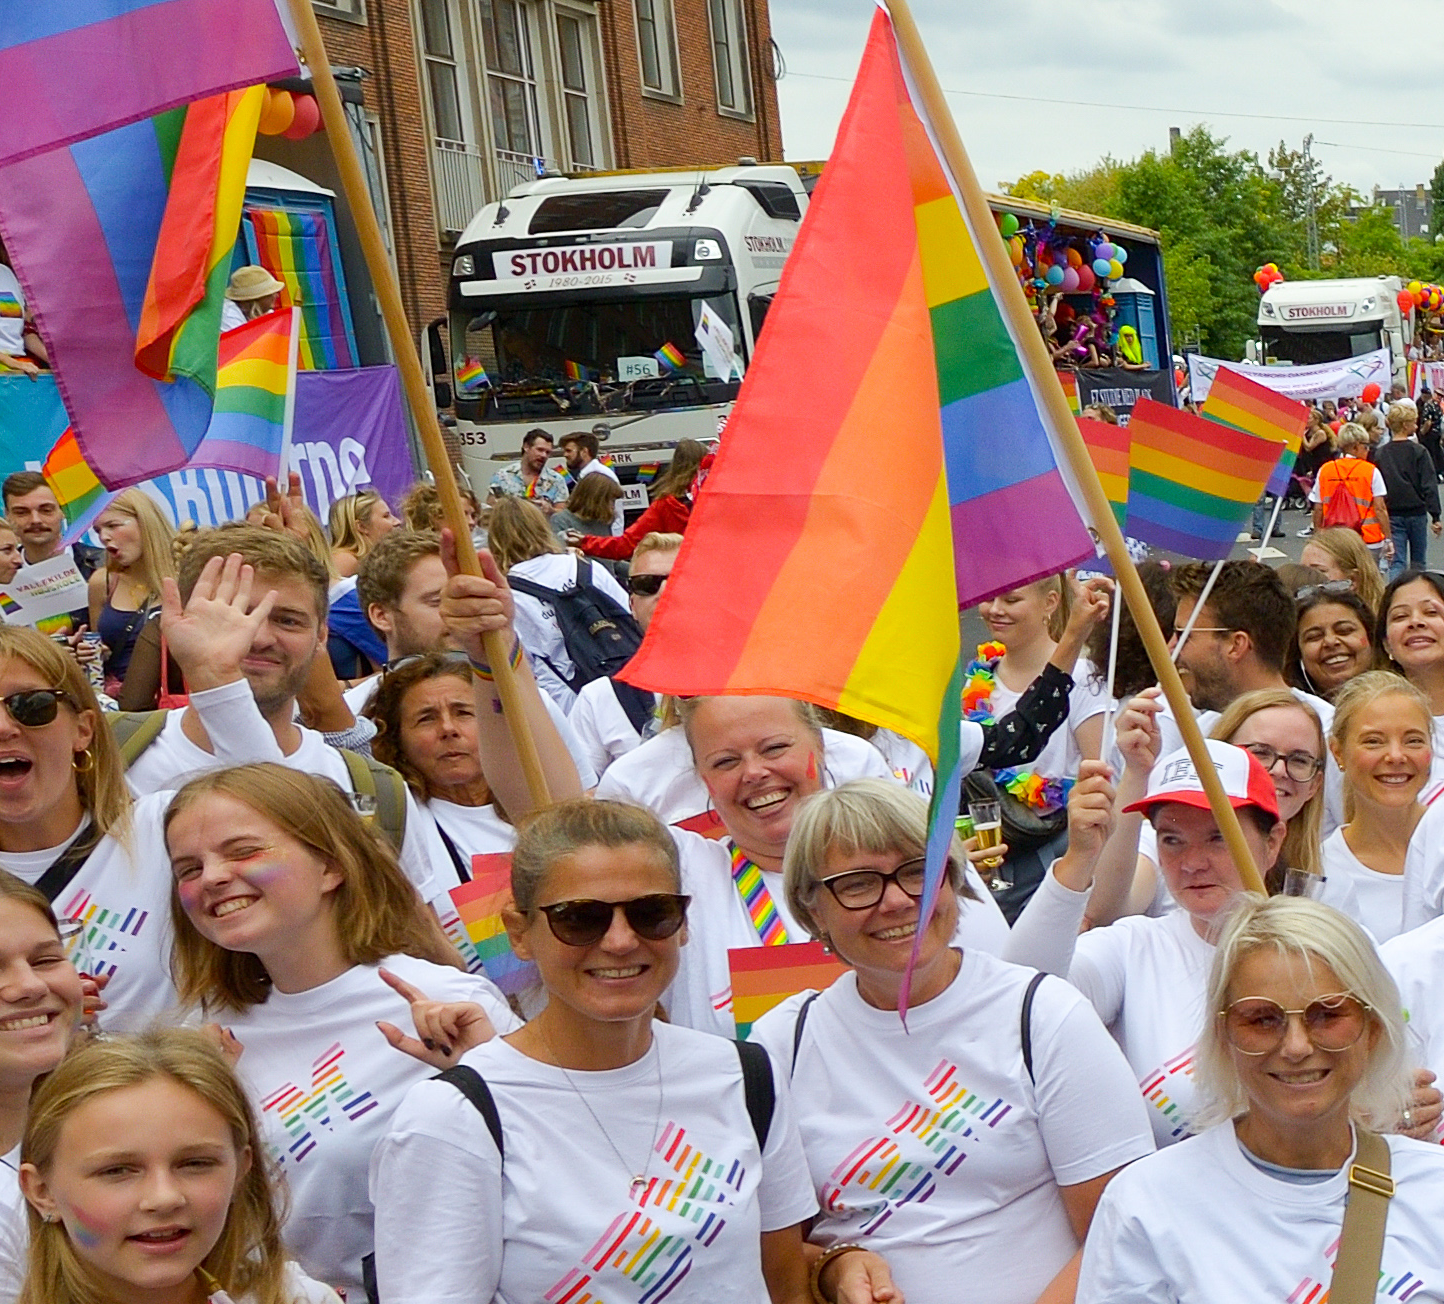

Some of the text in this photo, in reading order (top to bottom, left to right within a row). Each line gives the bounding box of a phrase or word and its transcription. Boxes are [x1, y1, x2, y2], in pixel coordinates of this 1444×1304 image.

[510, 245, 656, 276] STOKHOLM
[549, 273, 613, 288] 1980-2015
[1288, 305, 1347, 319] STOKHOLM
[626, 363, 651, 377] #56
